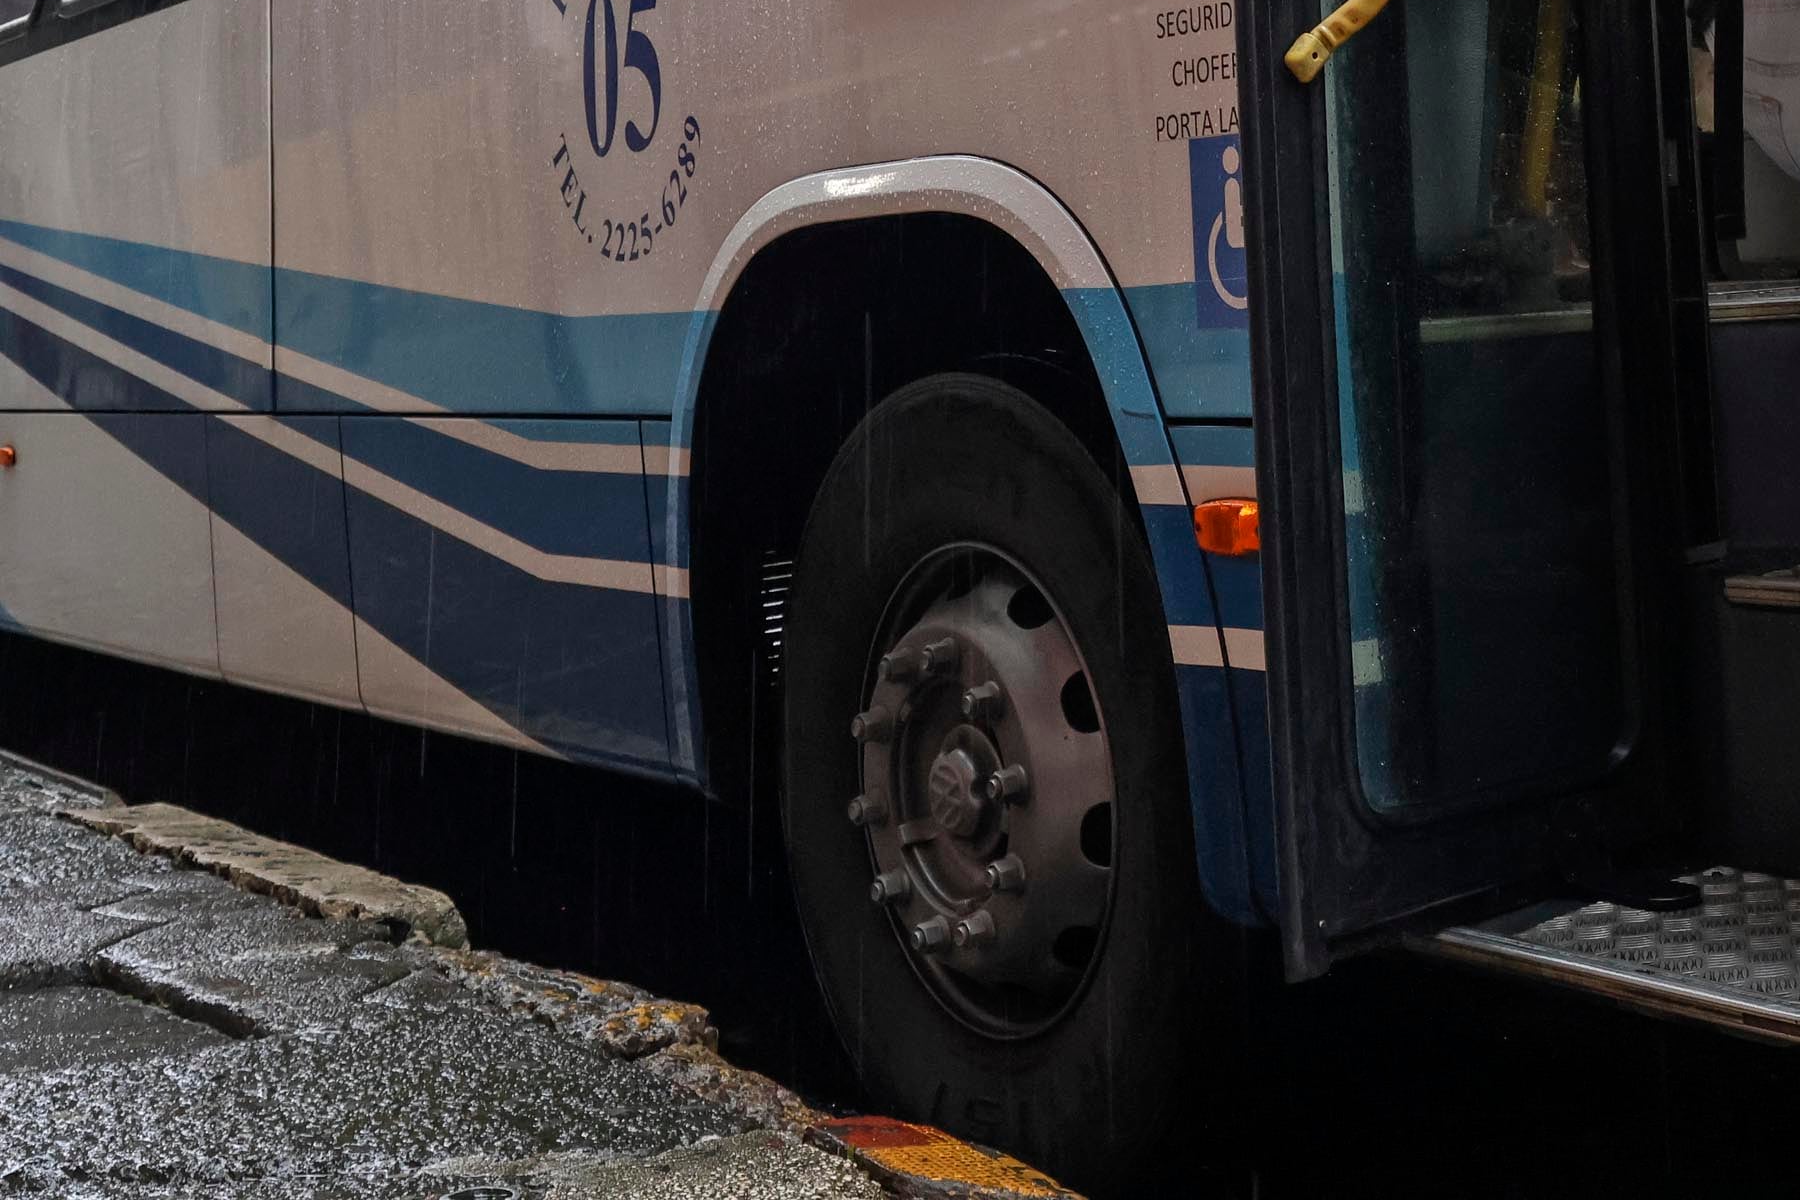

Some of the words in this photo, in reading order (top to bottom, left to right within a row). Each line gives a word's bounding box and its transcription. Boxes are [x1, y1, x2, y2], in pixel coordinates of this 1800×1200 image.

[1156, 110, 1214, 142] PORTA
[552, 131, 595, 244] TEL.
[600, 115, 702, 263] 2225-6289
